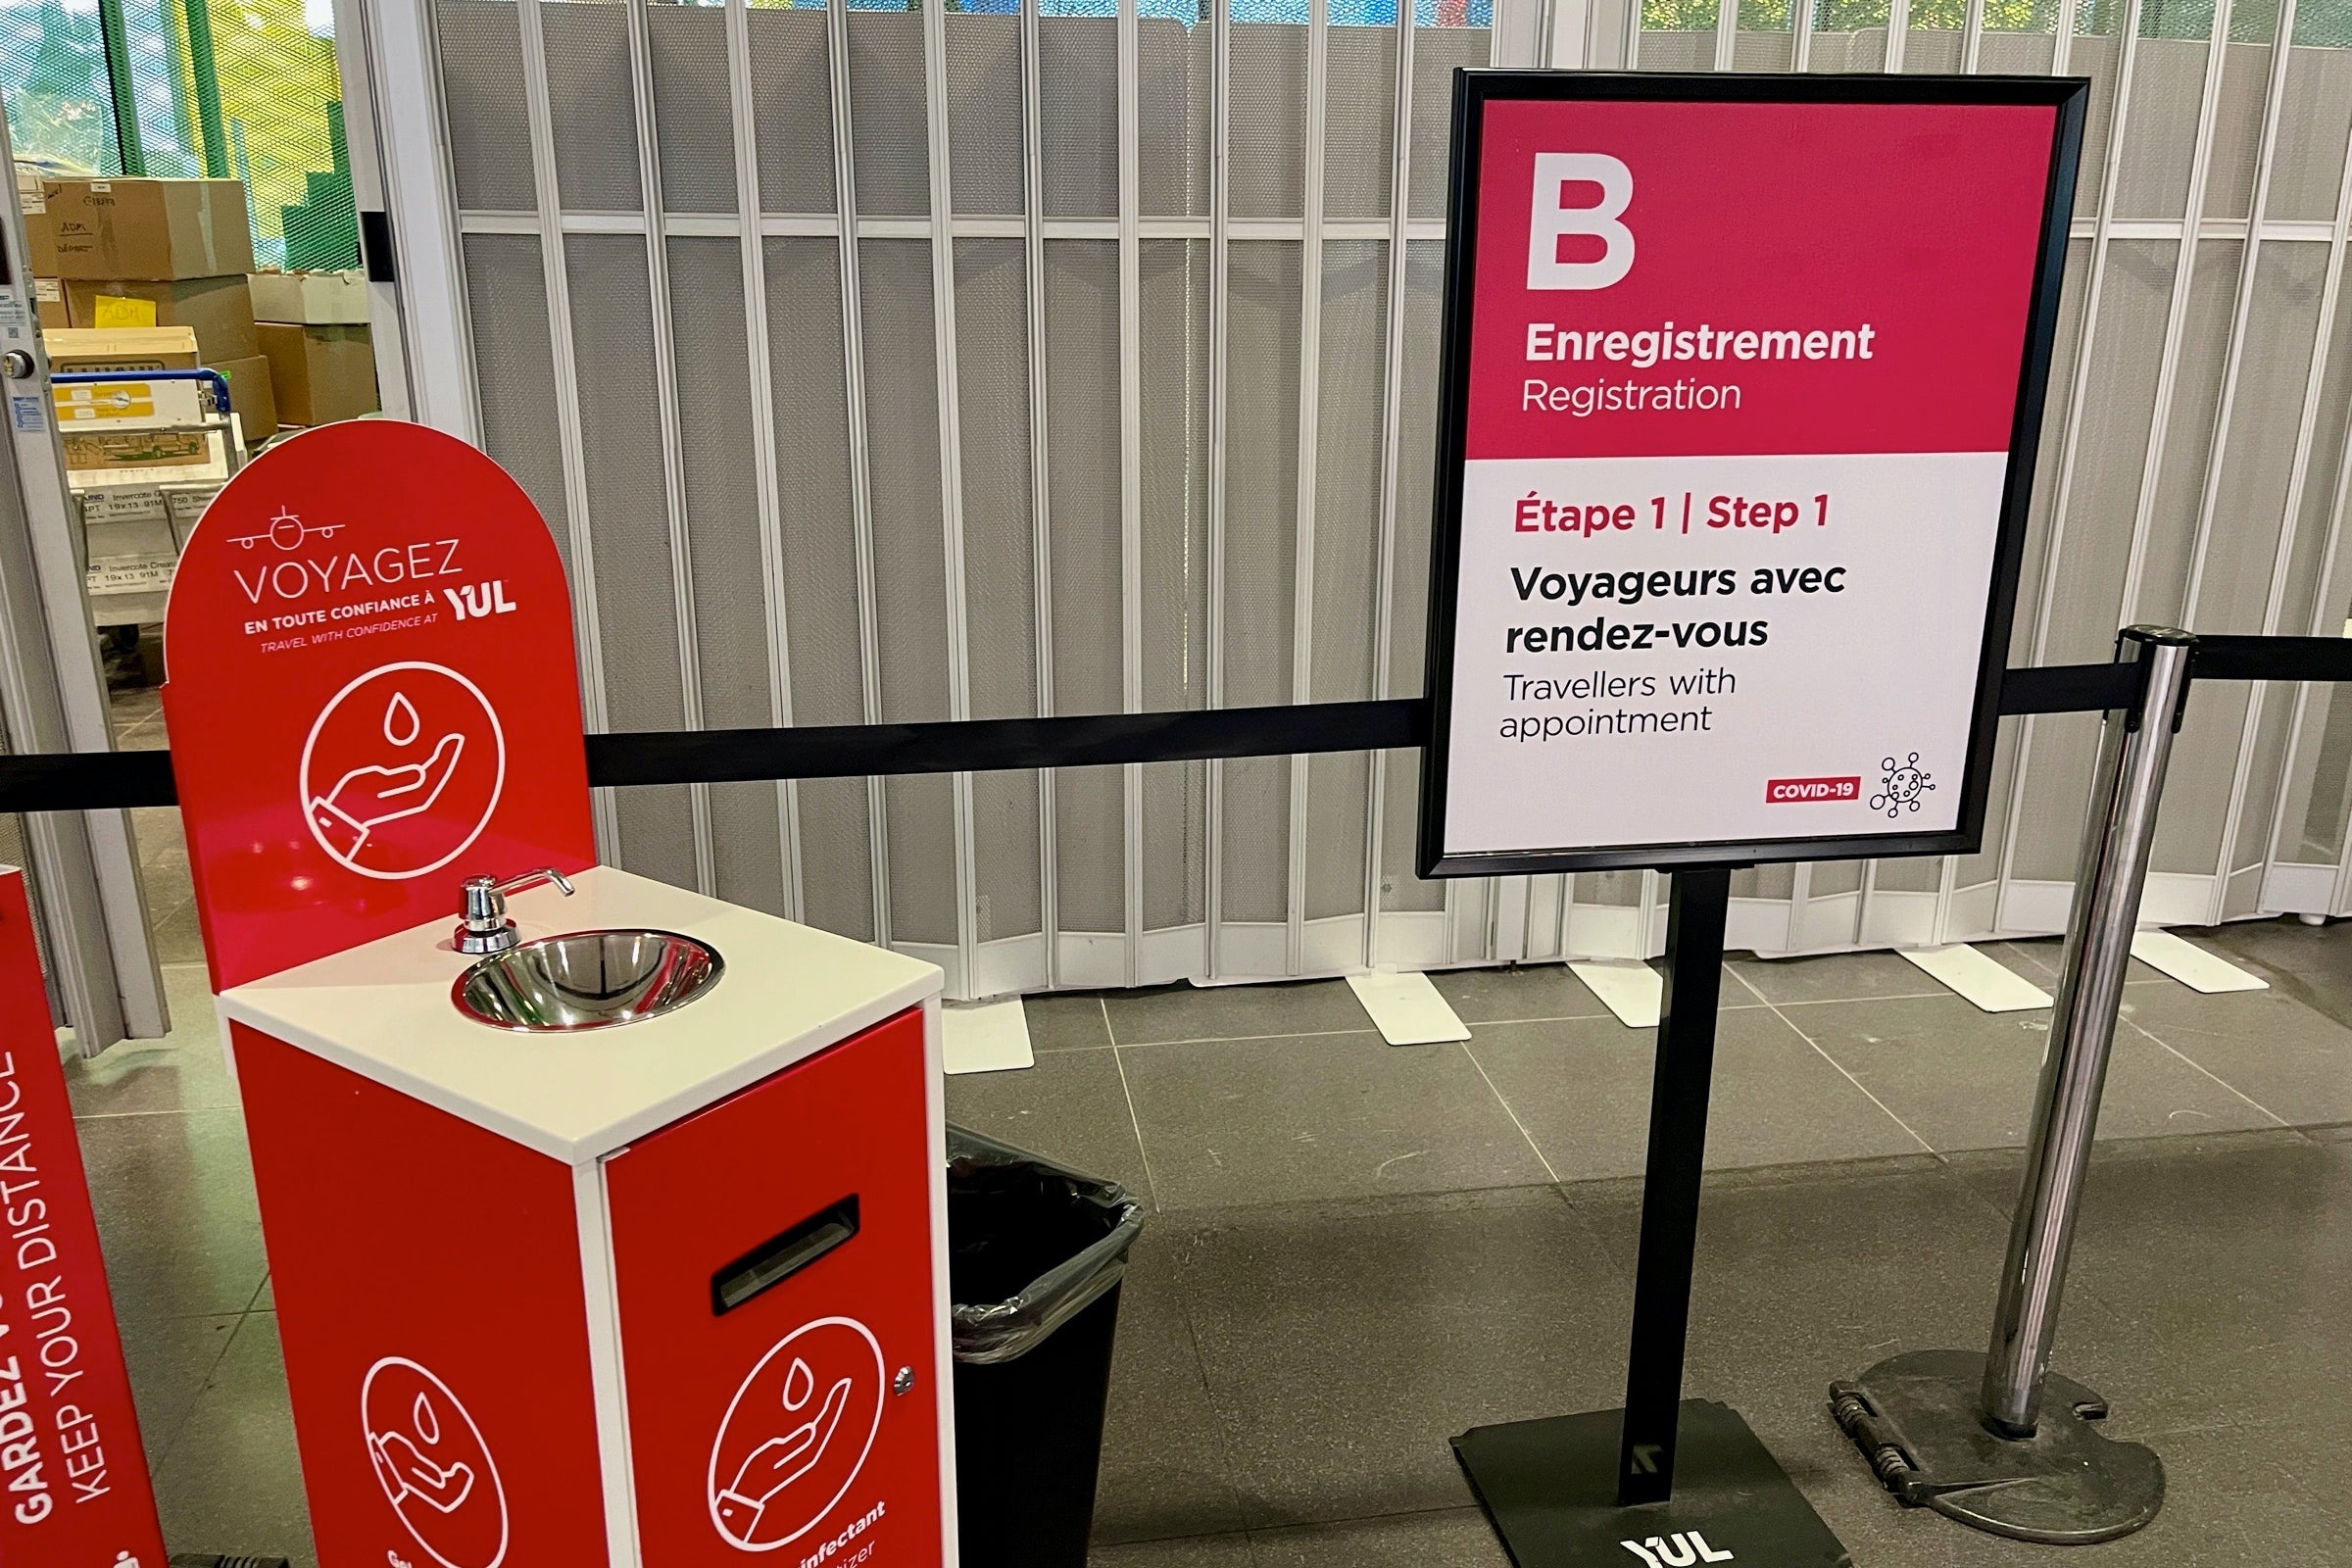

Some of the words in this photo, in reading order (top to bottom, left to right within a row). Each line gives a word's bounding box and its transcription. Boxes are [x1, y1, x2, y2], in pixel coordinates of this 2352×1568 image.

[1526, 152, 1636, 290] B
[1525, 321, 1876, 368] Enregistrement
[1522, 377, 1741, 417] Registration
[1515, 490, 1636, 538] Étape
[1650, 497, 1665, 529] 1
[1706, 496, 1799, 533] Step
[1814, 494, 1829, 526] 1
[233, 538, 464, 605] VOYAGEZ
[1510, 566, 1737, 607] Voyageurs
[1750, 566, 1847, 595] avec
[245, 619, 269, 635] EN
[271, 610, 326, 629] TOUTE
[331, 594, 420, 620] CONFIANCE
[424, 590, 435, 605] À
[443, 580, 516, 621] YUL
[261, 637, 308, 654] TRAVEL
[312, 630, 343, 645] WITH
[346, 616, 421, 639] CONFIDENCE
[423, 612, 438, 625] AT
[1505, 616, 1769, 654] rendez-vous
[1503, 670, 1656, 701] Travellers
[1670, 666, 1737, 697] with
[1499, 706, 1713, 743] appointment
[1773, 782, 1854, 800] COVID-19
[25, 1275, 84, 1397] YOUR
[55, 1404, 111, 1504] KEEP
[798, 1500, 886, 1568] infectant
[1619, 1530, 1735, 1568] YUL
